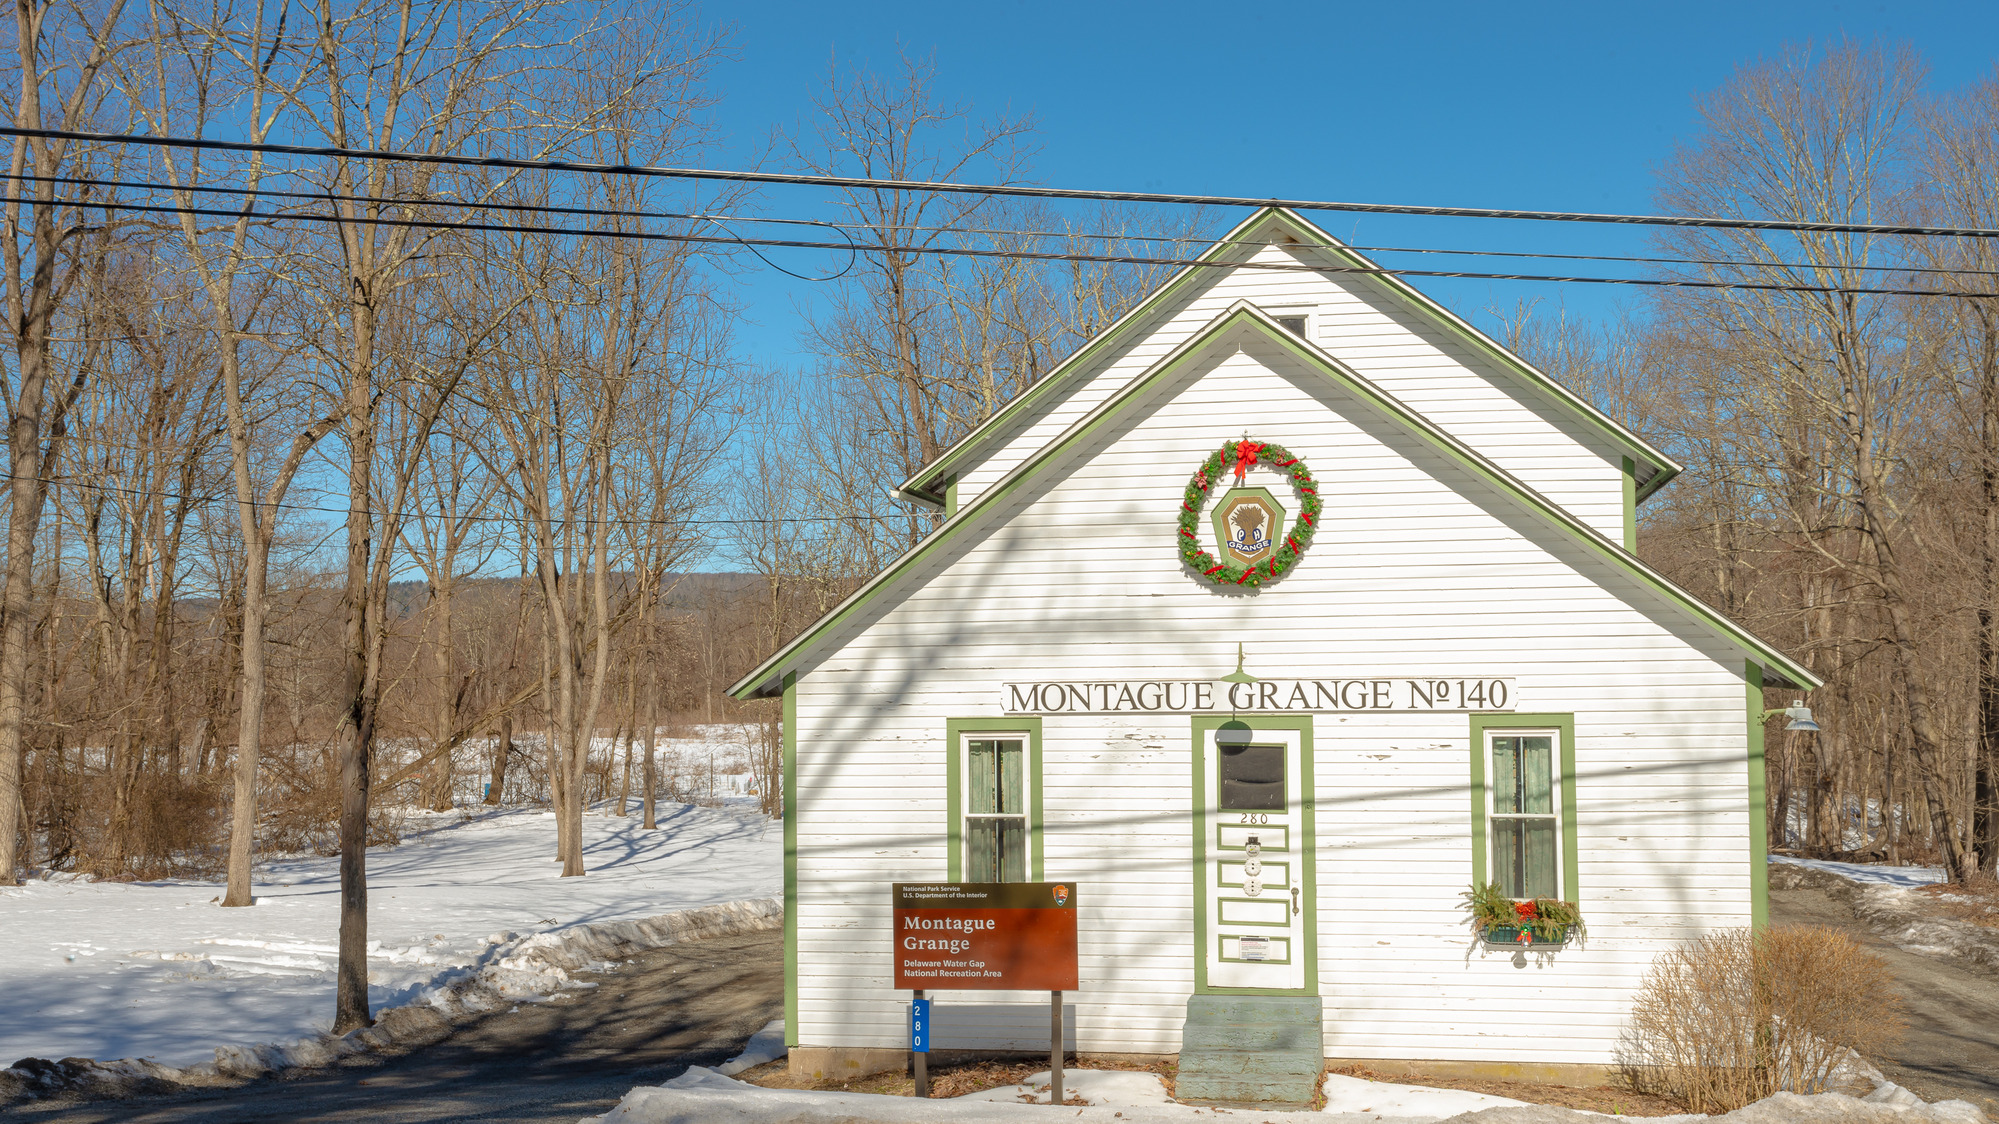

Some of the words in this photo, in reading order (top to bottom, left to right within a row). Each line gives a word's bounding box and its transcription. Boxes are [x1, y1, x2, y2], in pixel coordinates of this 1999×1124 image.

[1238, 529, 1244, 540] P
[1253, 530, 1260, 540] H
[1229, 540, 1270, 551] GRANGE
[1008, 682, 1215, 712] MONTAGUE
[1228, 680, 1394, 710] GRANGE
[1241, 813, 1268, 824] 280
[903, 916, 996, 934] Montague
[903, 936, 970, 954] Grange
[904, 959, 941, 968] Delaware
[943, 959, 968, 968] Water
[969, 959, 985, 969] Gap
[904, 969, 938, 977] National
[939, 969, 982, 977] Recreation
[983, 970, 1002, 978] Area
